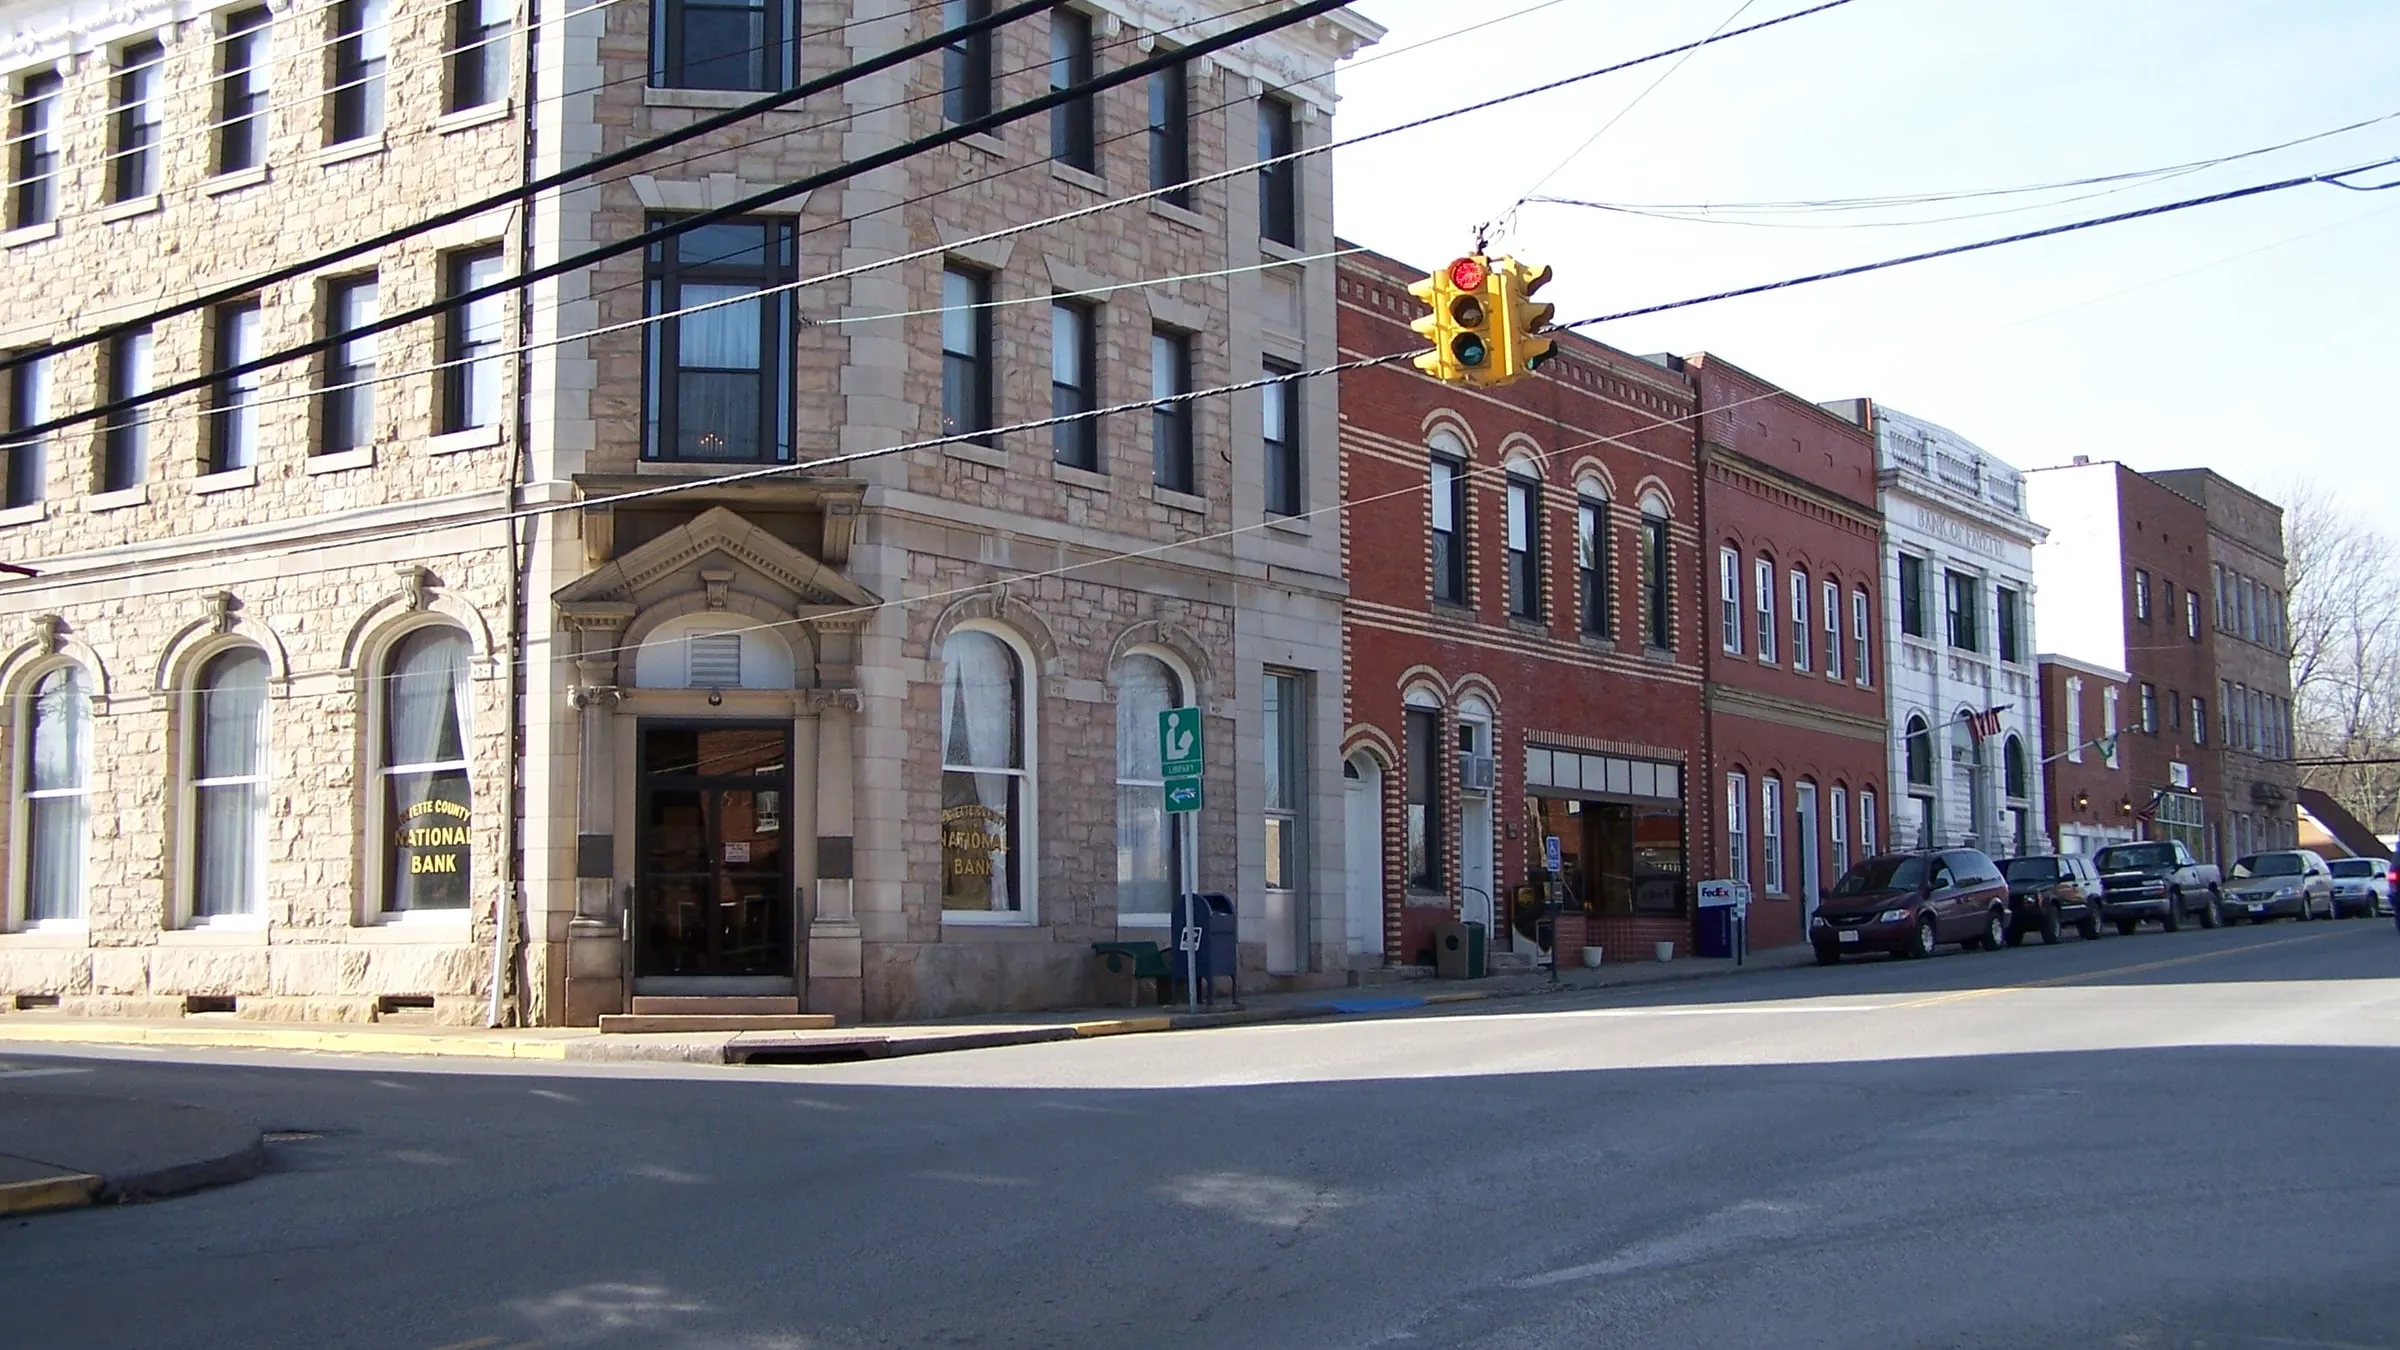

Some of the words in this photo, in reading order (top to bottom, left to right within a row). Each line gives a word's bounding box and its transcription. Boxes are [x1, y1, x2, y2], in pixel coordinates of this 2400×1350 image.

[1917, 508, 1947, 537] BANK
[1966, 527, 2006, 558] FAYETTE
[435, 799, 471, 821] COUNTY
[395, 826, 472, 847] NATIONAL
[411, 854, 456, 874] BANK
[954, 858, 994, 875] BANK
[1701, 887, 1729, 898] FedEx
